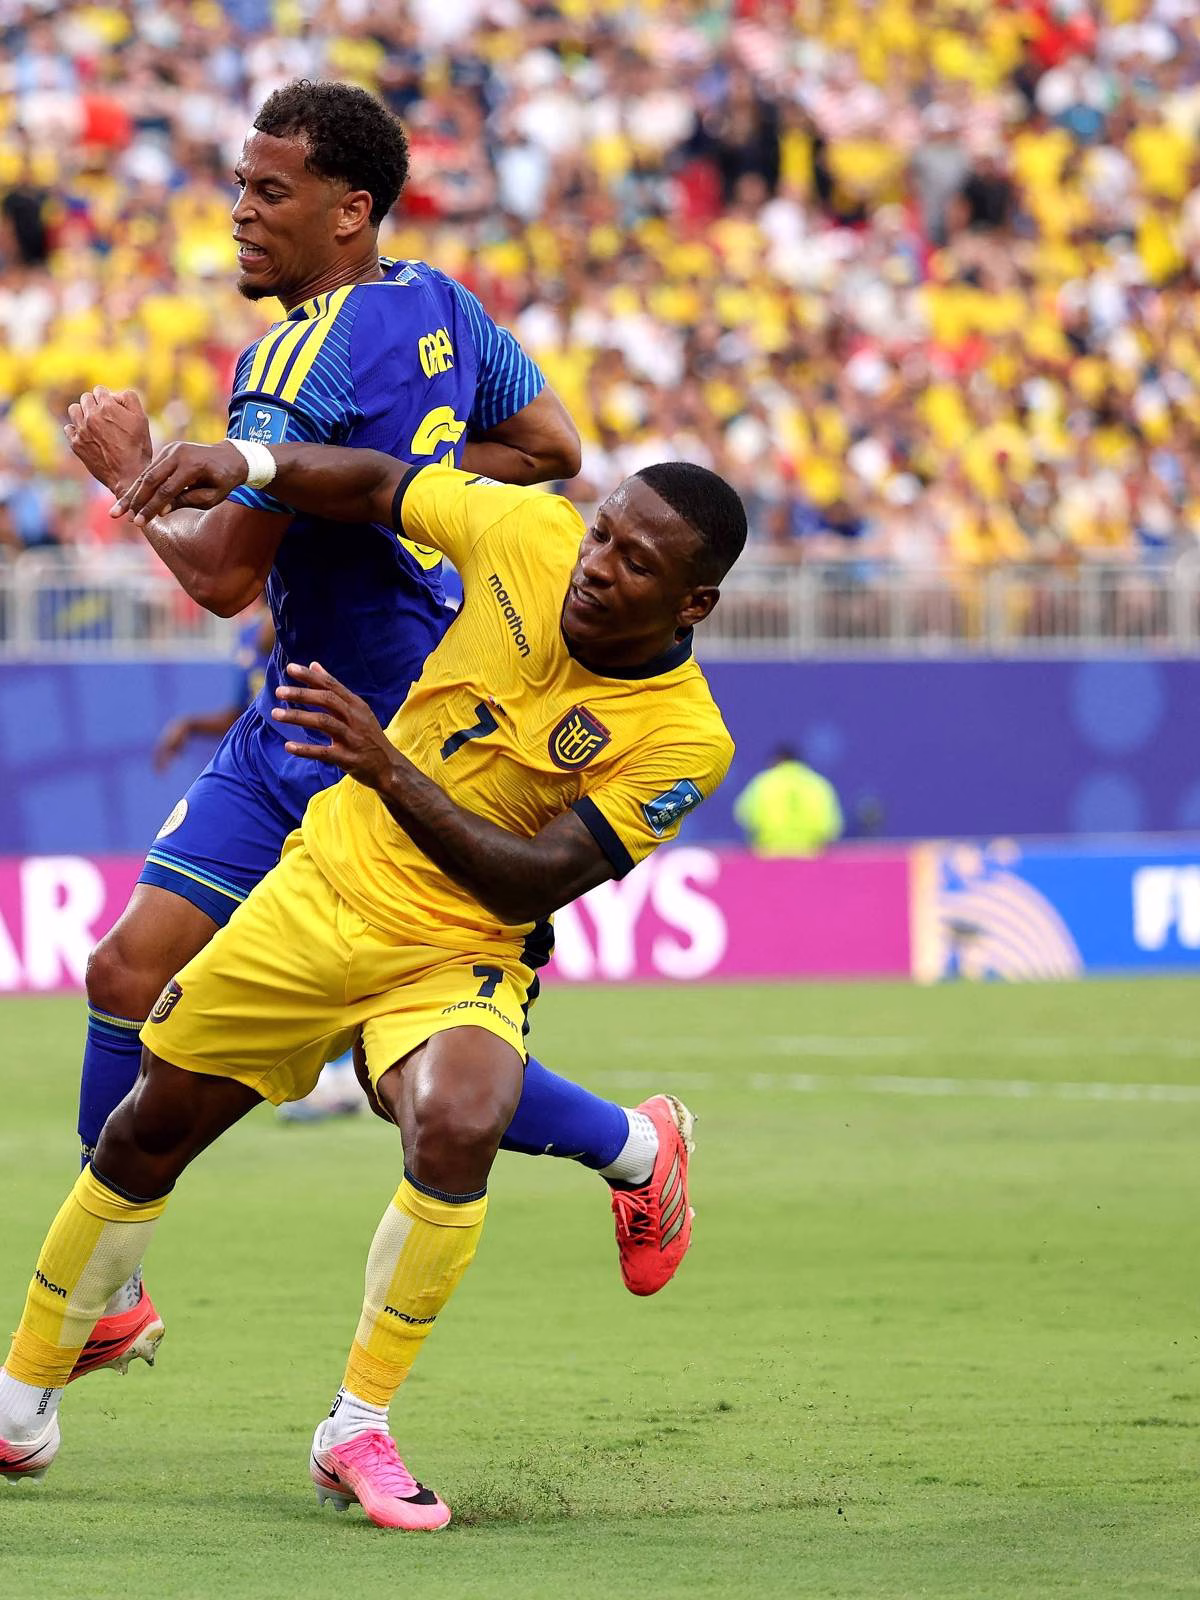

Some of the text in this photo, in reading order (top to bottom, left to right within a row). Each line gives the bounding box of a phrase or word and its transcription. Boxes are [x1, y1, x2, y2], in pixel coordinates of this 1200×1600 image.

[487, 572, 531, 659] marathon
[439, 701, 500, 762] 7
[472, 965, 504, 999] 7
[441, 1000, 519, 1034] marathon
[35, 1269, 67, 1299] thon
[36, 1387, 54, 1415] ESIGN
